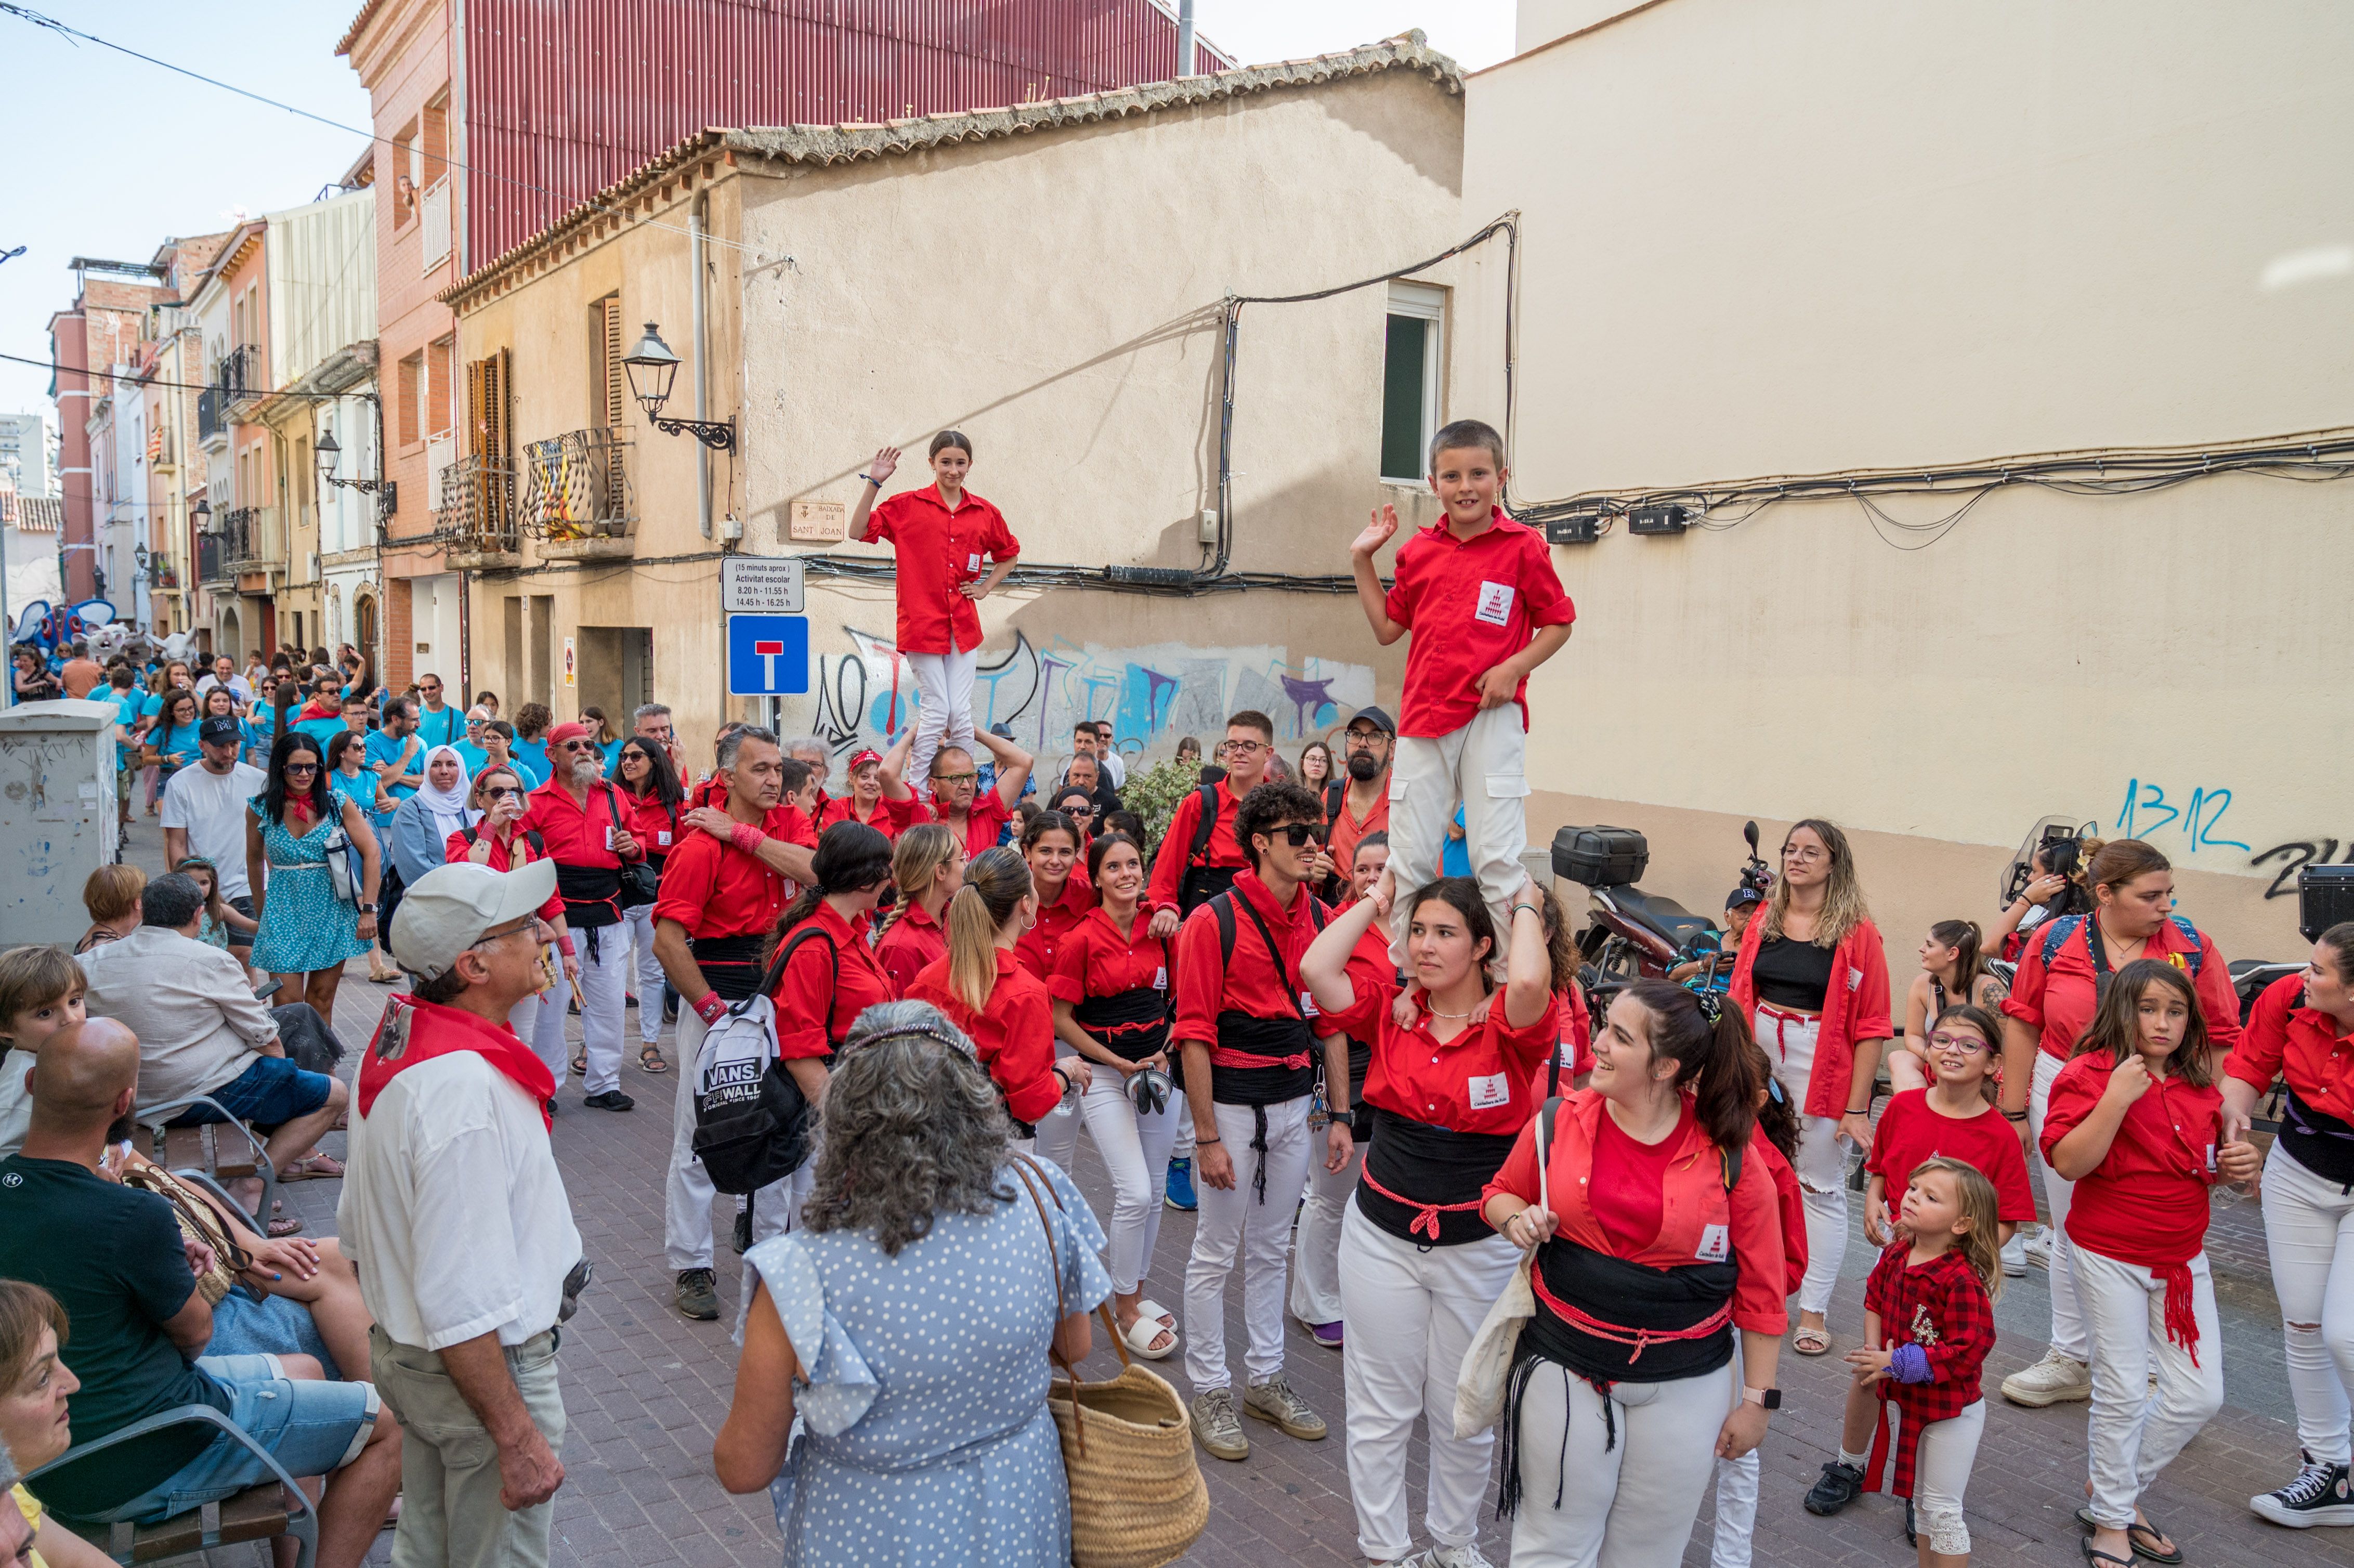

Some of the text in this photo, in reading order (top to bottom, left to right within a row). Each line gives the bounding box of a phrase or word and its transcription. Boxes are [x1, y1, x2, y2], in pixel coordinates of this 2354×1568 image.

[793, 526, 814, 534] SANT
[736, 564, 745, 572] (15
[214, 720, 232, 731] M
[1743, 888, 1755, 898] R
[708, 1063, 755, 1086] VANS
[723, 1084, 761, 1100] WALL
